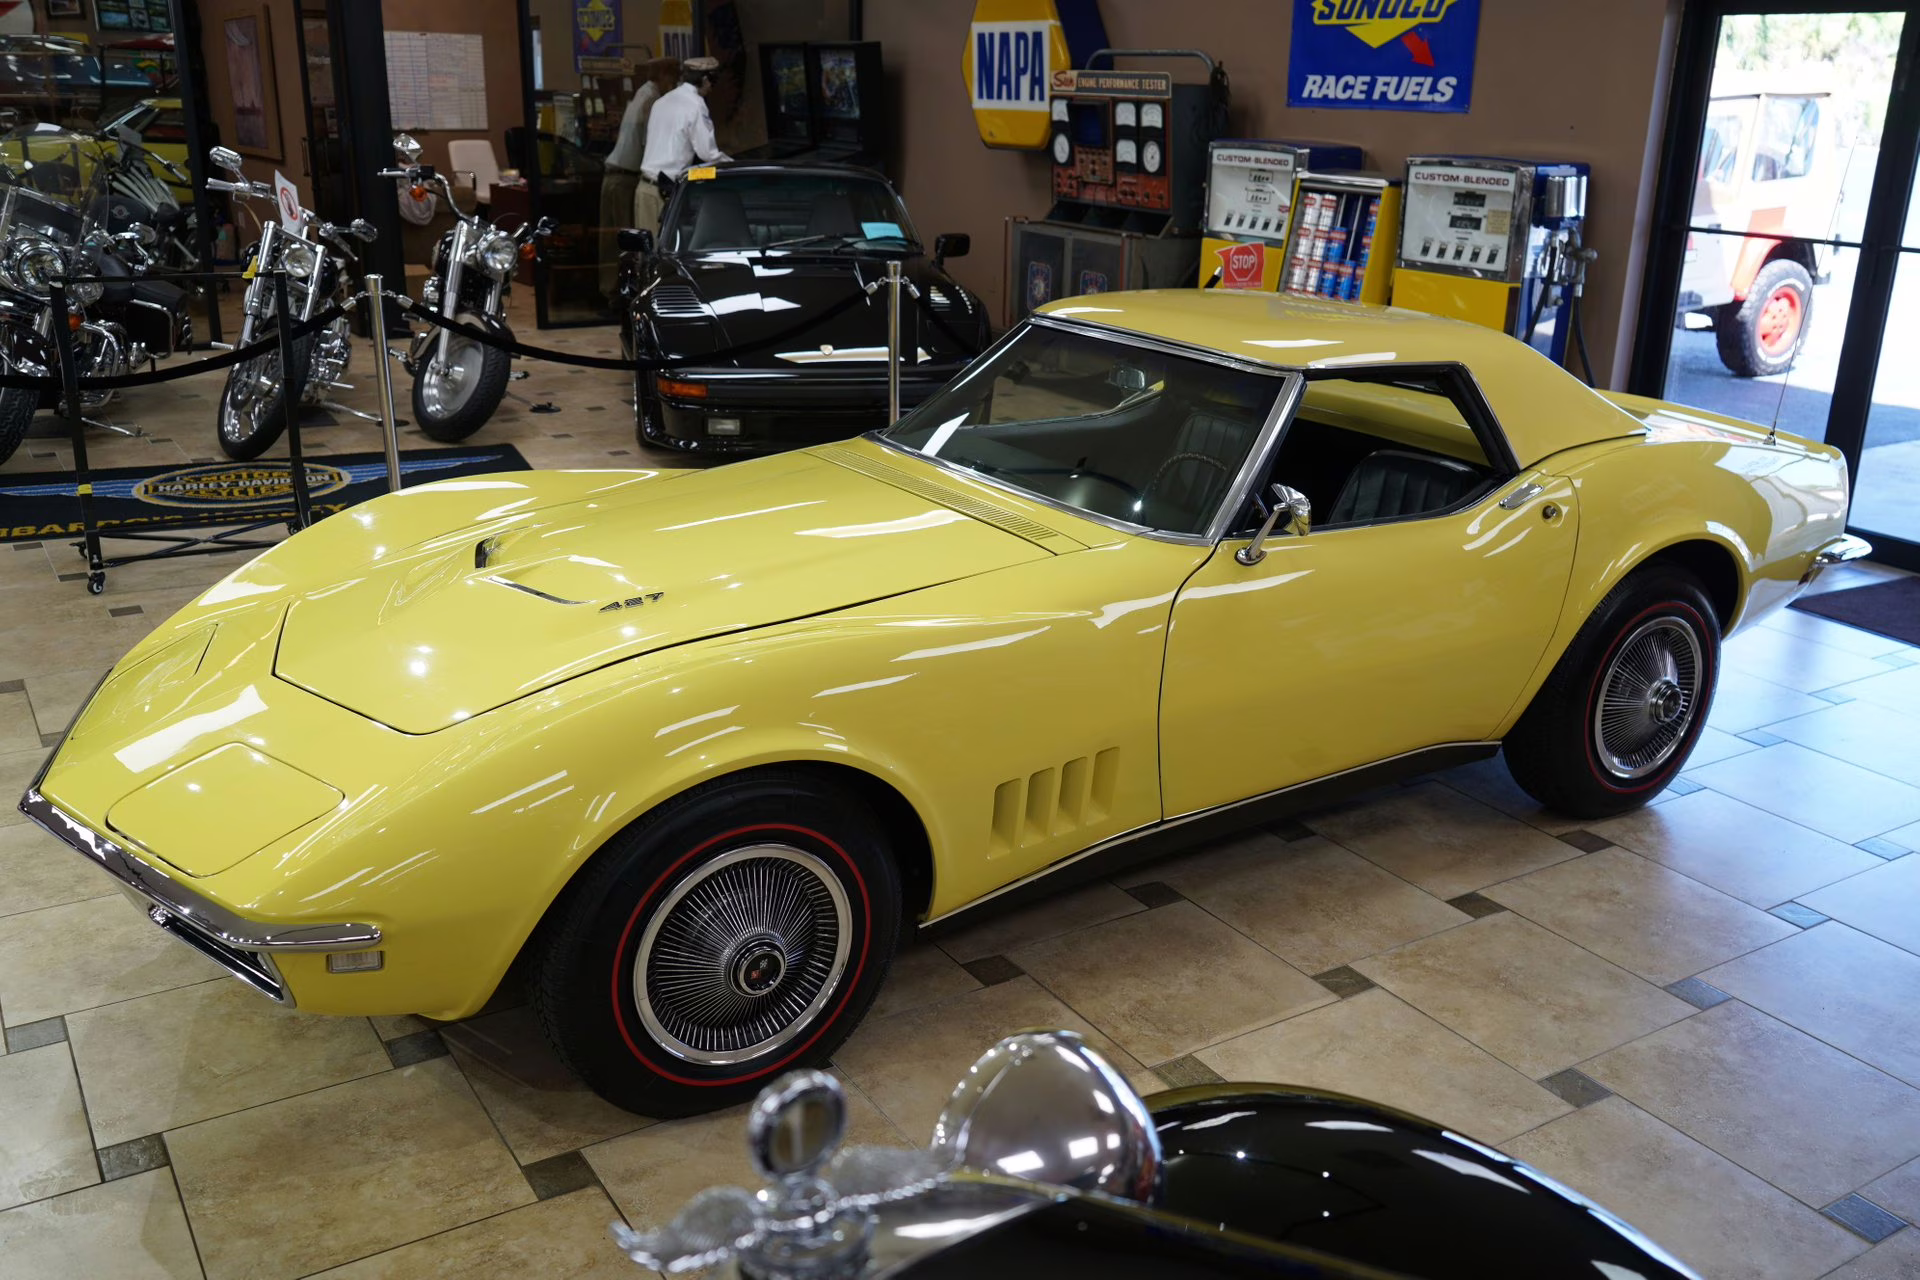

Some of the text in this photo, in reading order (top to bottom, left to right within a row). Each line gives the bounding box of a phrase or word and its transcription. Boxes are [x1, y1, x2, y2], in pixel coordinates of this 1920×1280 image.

[1317, 0, 1447, 20] SUNOCO
[977, 31, 1045, 102] NAPA
[1099, 78, 1139, 90] PERFORMANCE
[1141, 79, 1166, 90] TESTER
[1301, 74, 1458, 103] RACE FUELS
[1216, 153, 1290, 167] CUSTOM-BLENDED
[1414, 171, 1510, 187] CUSTOM-BLENDED
[1231, 254, 1256, 271] STOP
[158, 473, 331, 493] HARLEY-DAVIDON
[599, 591, 664, 613] 427
